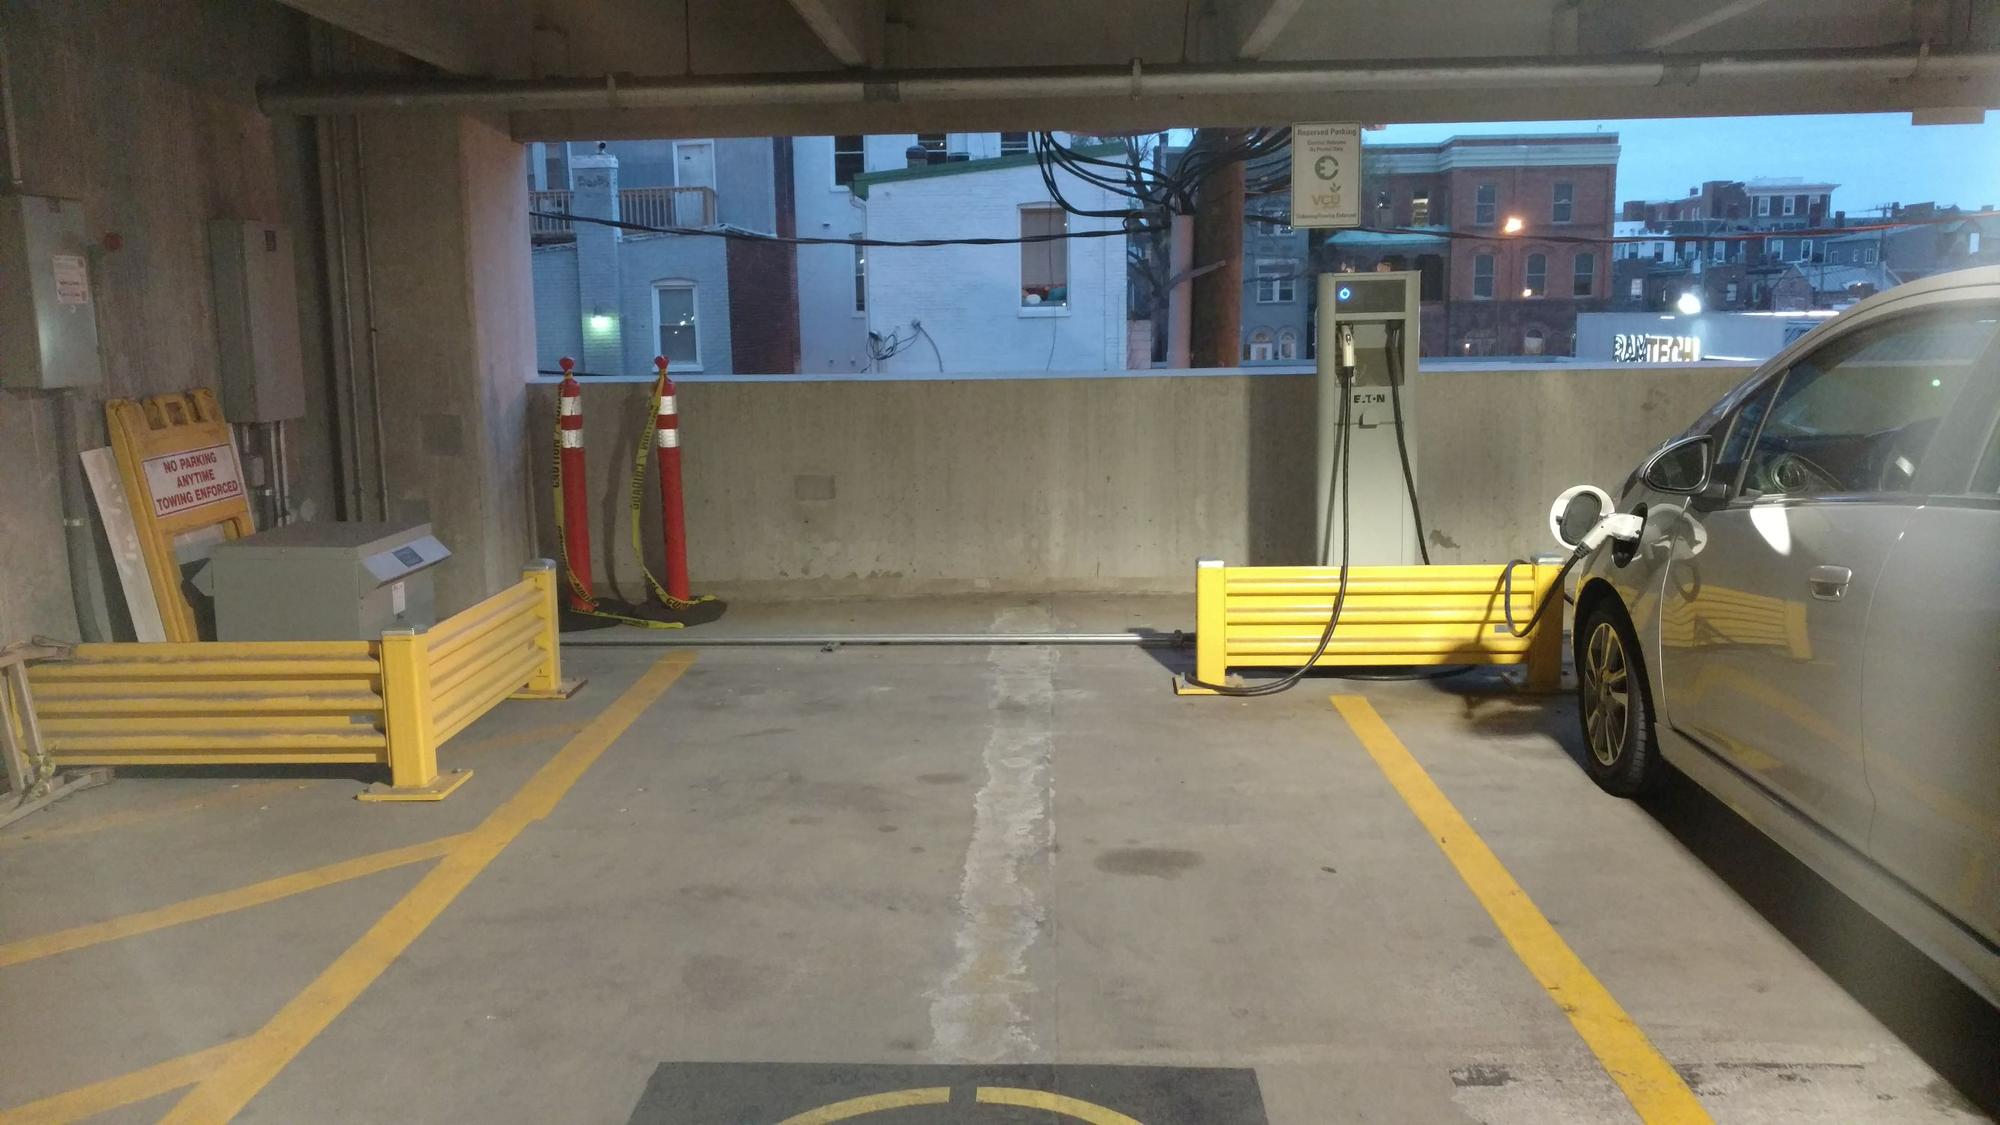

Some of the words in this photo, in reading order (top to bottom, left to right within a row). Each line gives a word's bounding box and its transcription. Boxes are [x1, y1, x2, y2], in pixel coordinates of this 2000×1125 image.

[1330, 128, 1357, 137] Parking
[163, 460, 178, 473] NO
[180, 452, 217, 470] PARKING
[177, 469, 216, 488] ANYTIME
[156, 491, 194, 511] TOWING
[194, 480, 239, 501] ENFORCED
